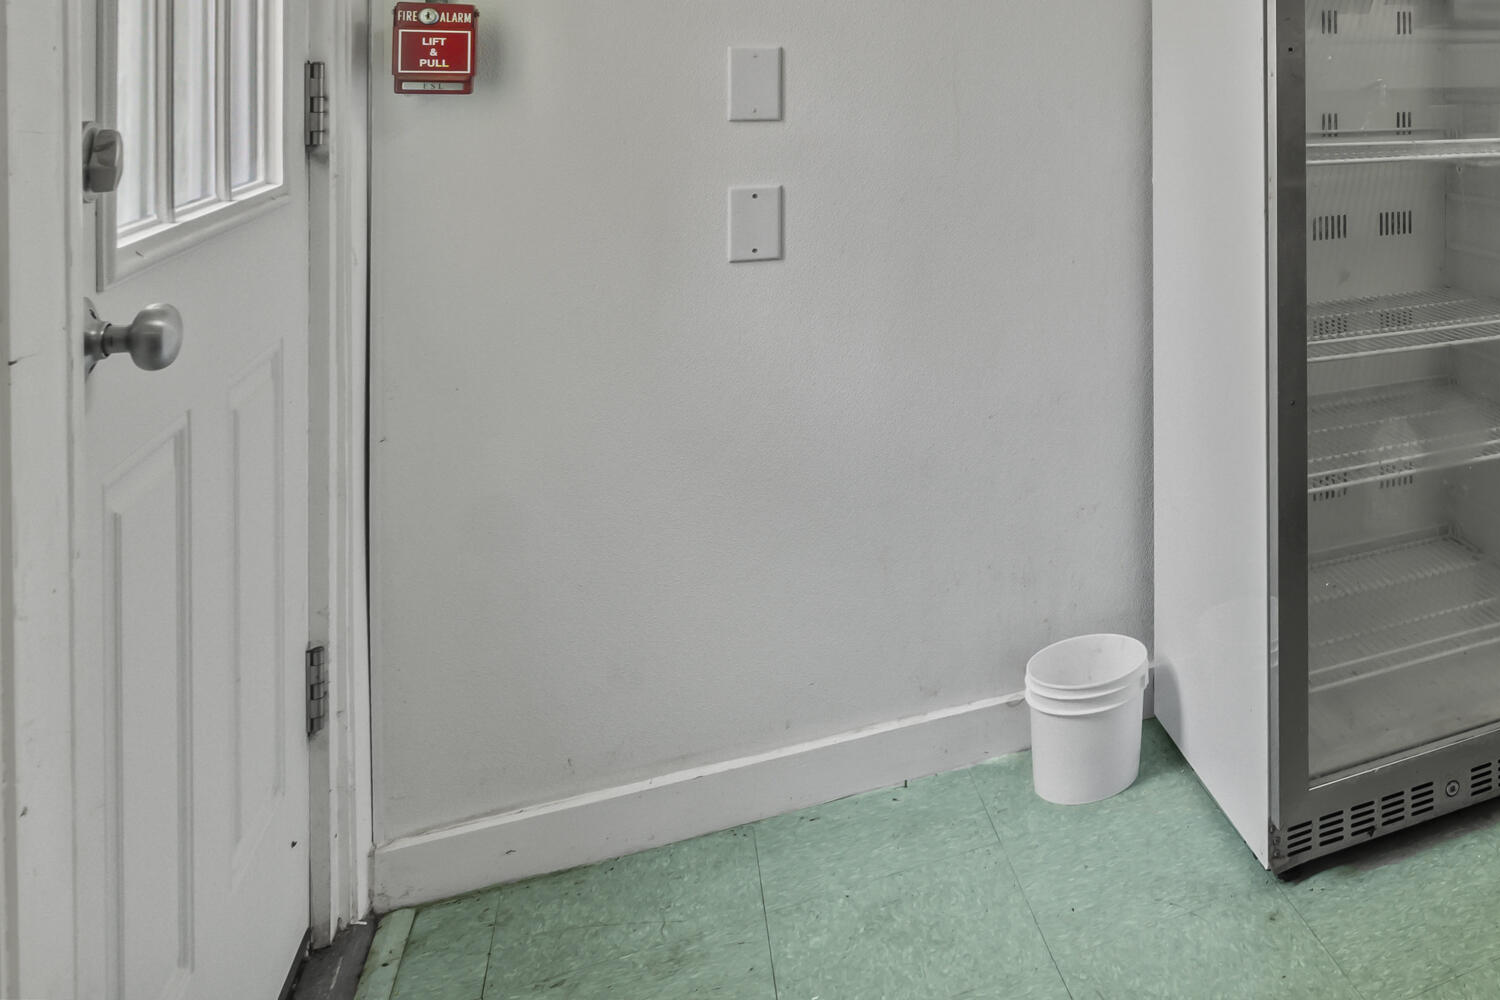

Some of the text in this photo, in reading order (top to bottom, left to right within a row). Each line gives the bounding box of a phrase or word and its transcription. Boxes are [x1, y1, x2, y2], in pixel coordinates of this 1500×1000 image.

[397, 10, 472, 23] FIRE ALARM
[422, 37, 447, 46] LIFT
[429, 48, 438, 57] &
[419, 59, 449, 68] PULL
